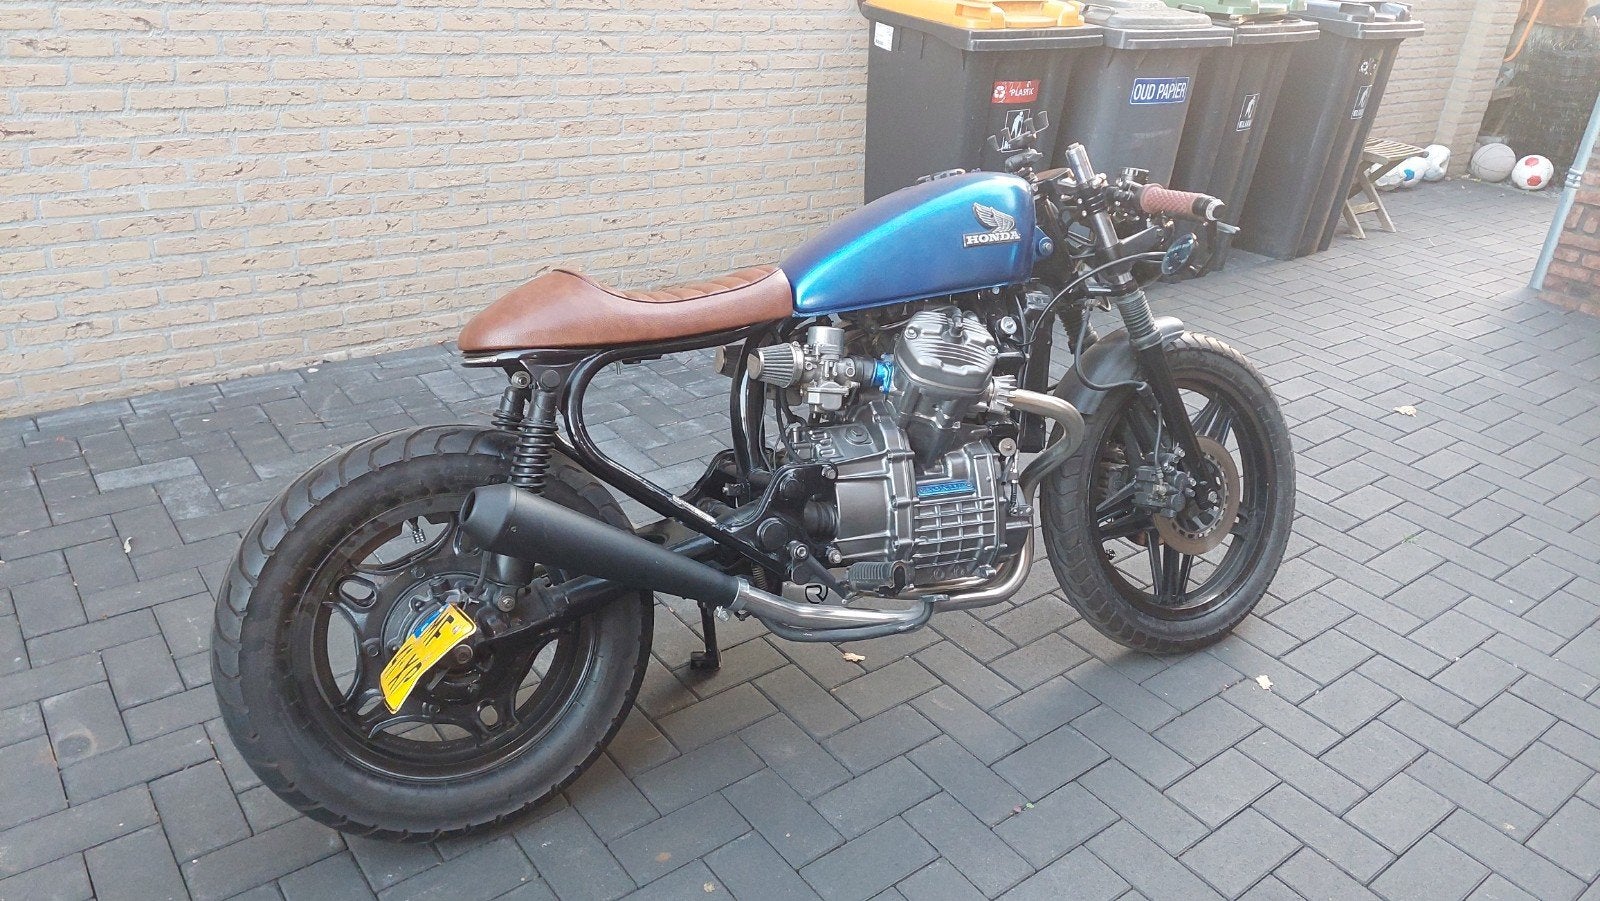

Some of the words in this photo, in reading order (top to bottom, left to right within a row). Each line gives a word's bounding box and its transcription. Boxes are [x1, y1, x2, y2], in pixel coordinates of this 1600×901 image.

[1133, 83, 1156, 100] OUD
[1156, 82, 1187, 100] PAPIER
[966, 230, 1021, 245] HONDA
